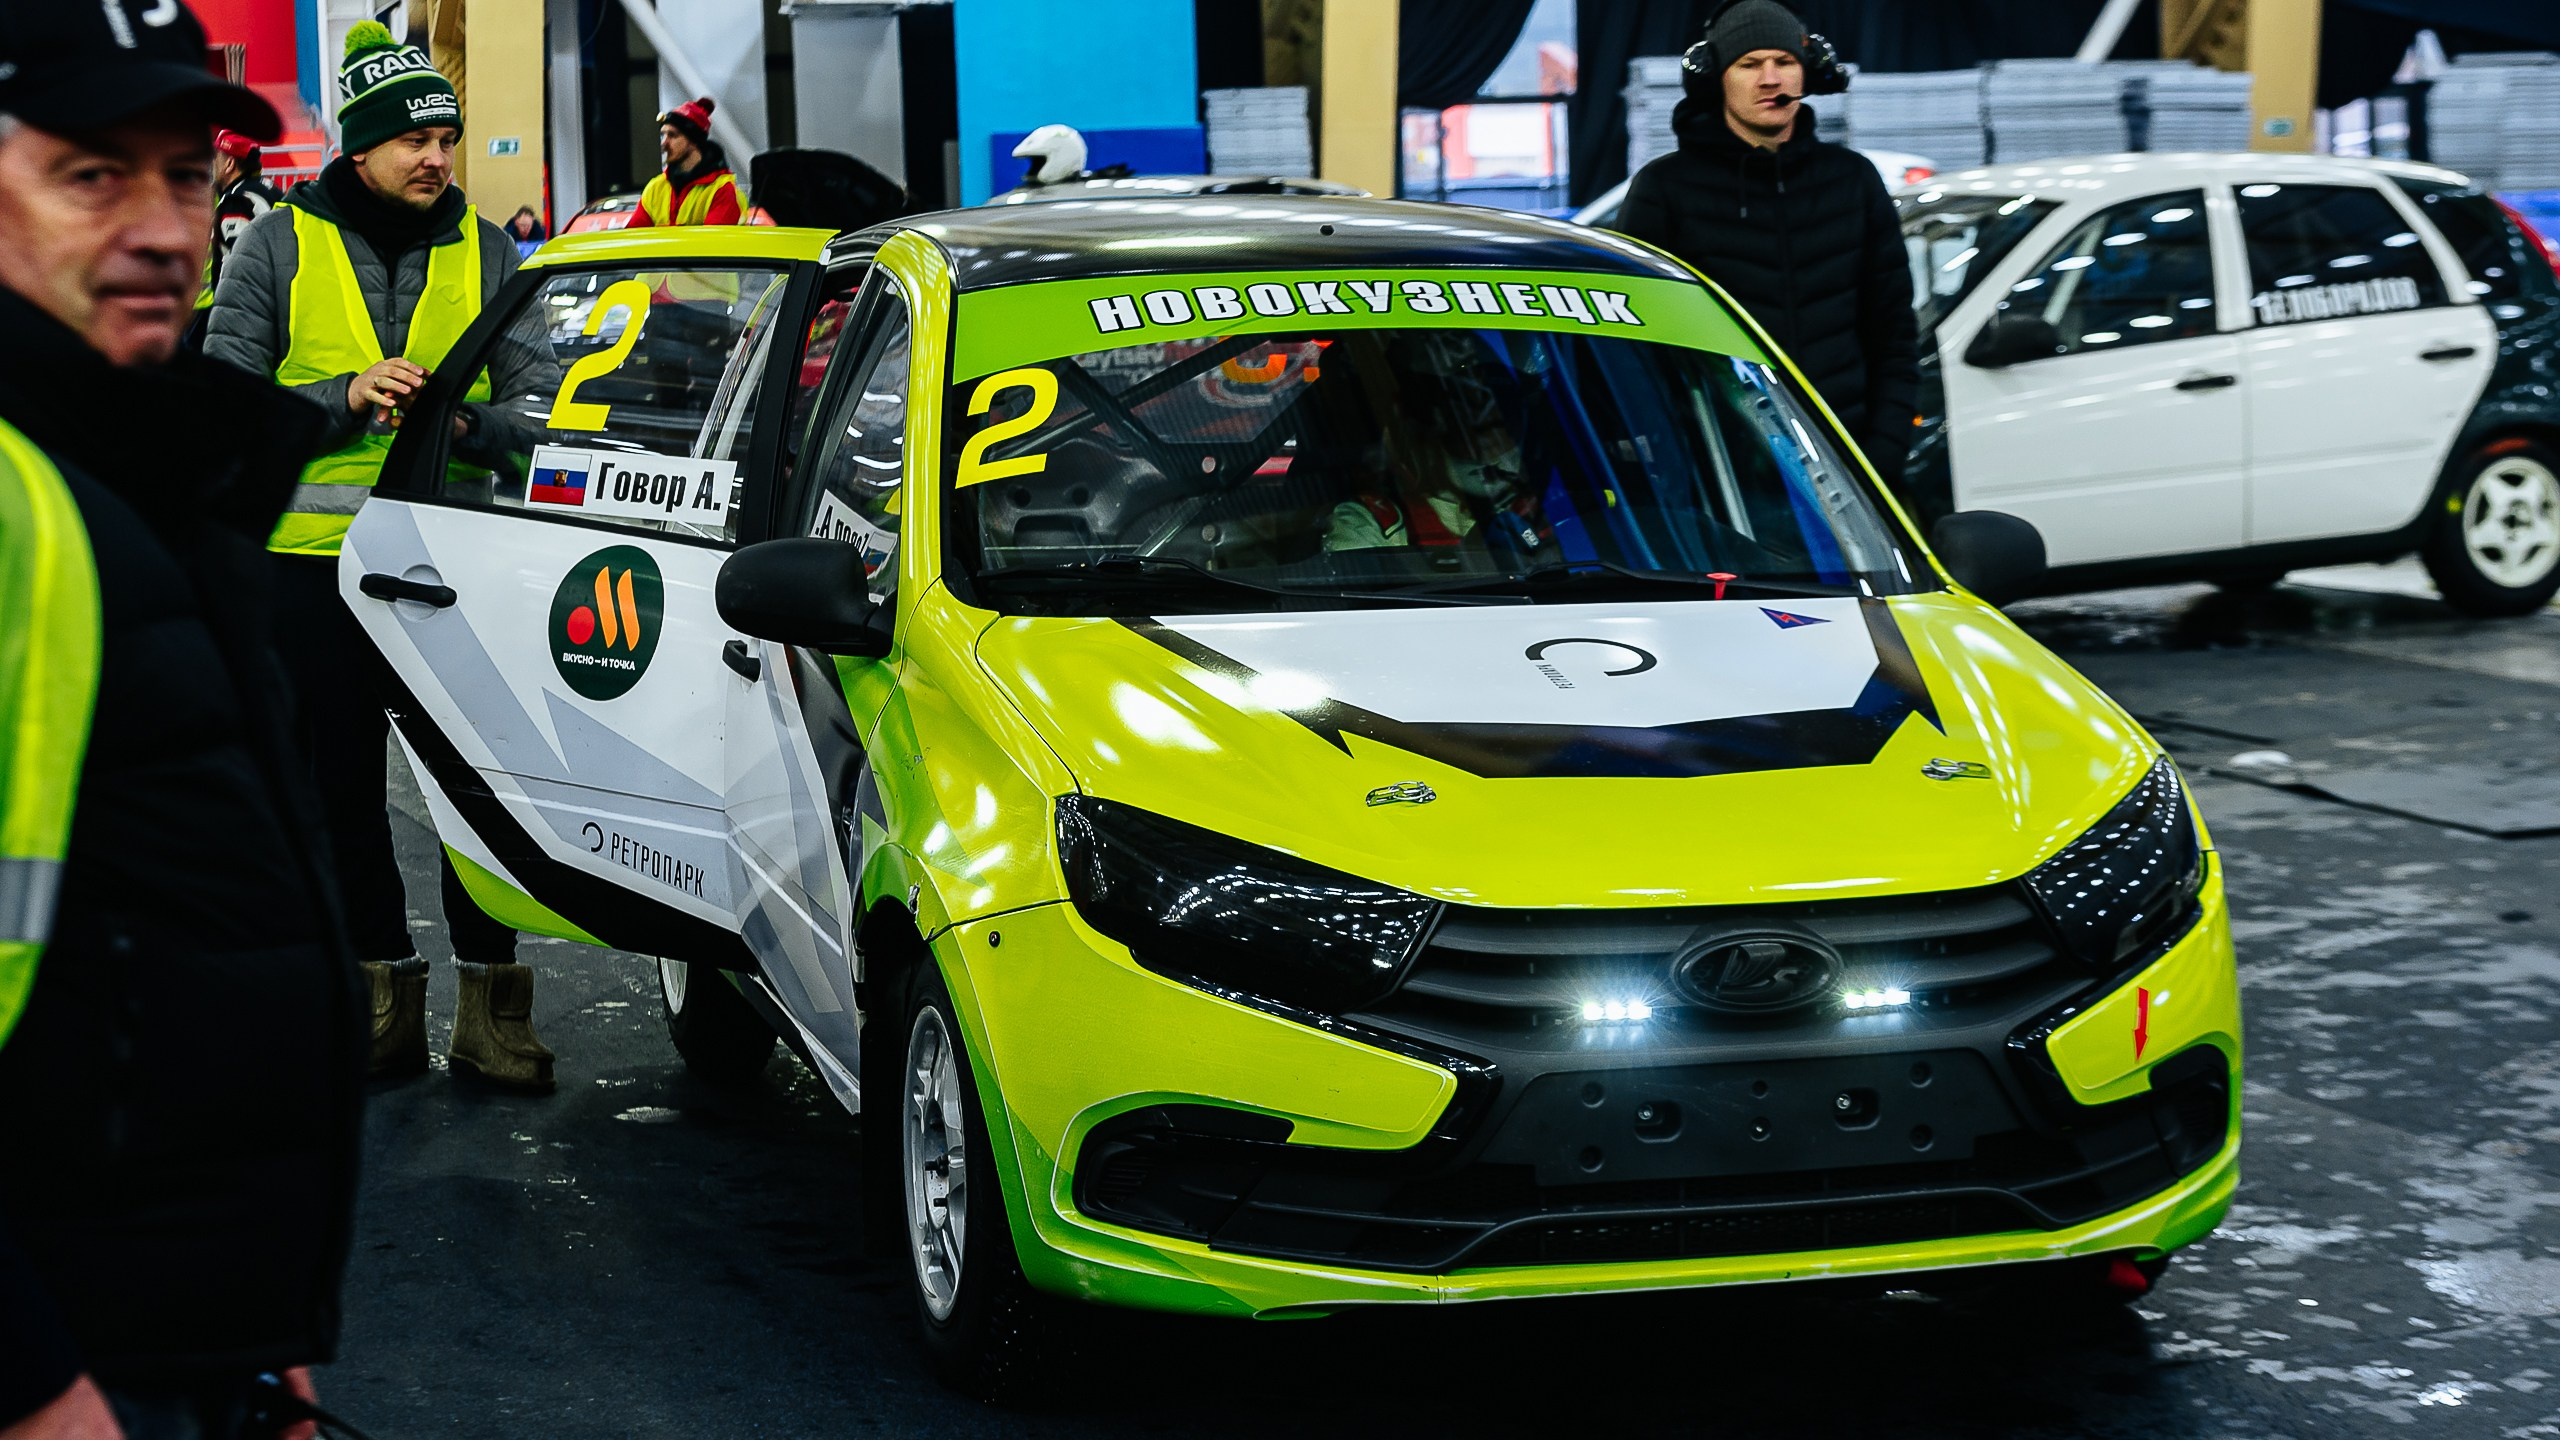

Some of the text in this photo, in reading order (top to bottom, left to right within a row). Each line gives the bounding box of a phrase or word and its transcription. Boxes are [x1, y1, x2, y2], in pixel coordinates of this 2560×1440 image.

[406, 94, 457, 111] WRC
[1090, 280, 1645, 333] НОВОКУЗНЕЦК
[547, 280, 651, 432] 2
[955, 368, 1059, 490] 2
[594, 462, 721, 513] Говор А.
[563, 652, 594, 665] ВКУСНО
[609, 659, 635, 670] ТОЧКА
[610, 832, 705, 898] РЕТРОПАРК
